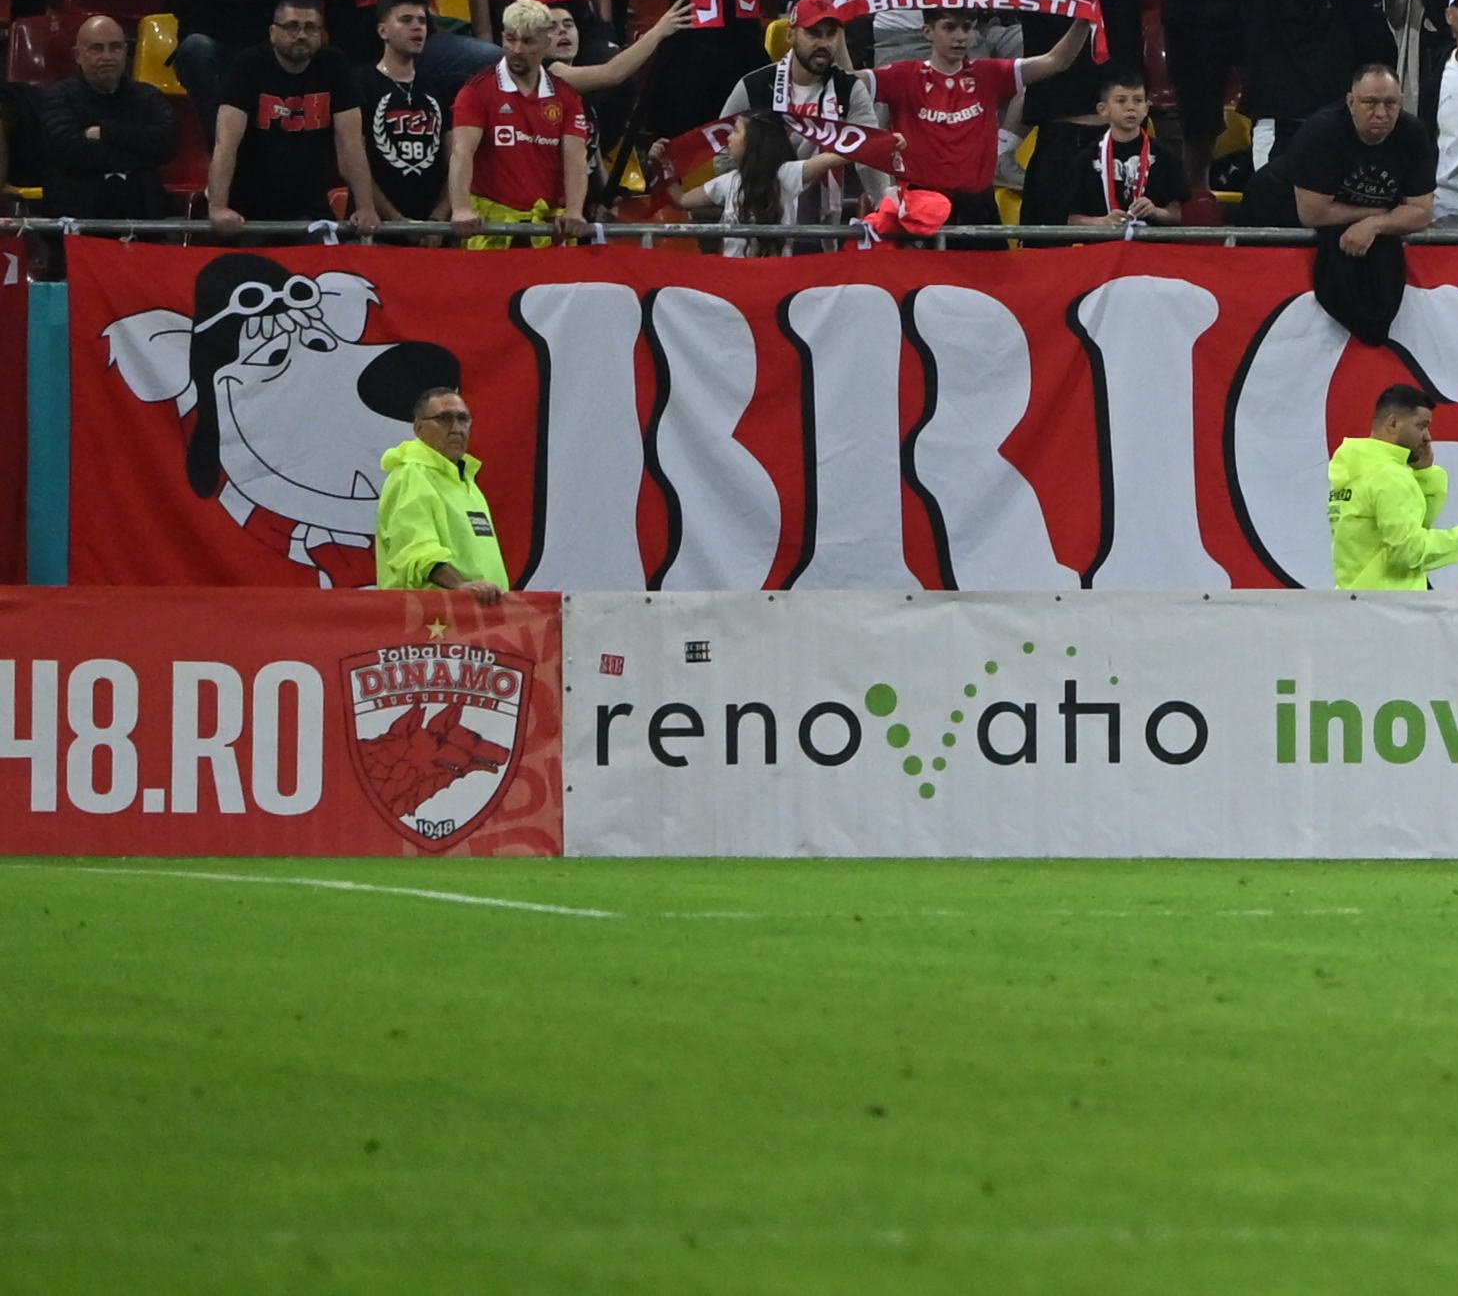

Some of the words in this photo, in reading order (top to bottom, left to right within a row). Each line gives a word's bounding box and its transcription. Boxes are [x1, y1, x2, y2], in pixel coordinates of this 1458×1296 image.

[257, 92, 332, 132] PCH
[917, 102, 985, 126] SUPERBET
[377, 645, 438, 666] Fotbal
[448, 644, 496, 664] Club
[359, 663, 520, 700] DINAMO
[416, 818, 454, 839] 1948
